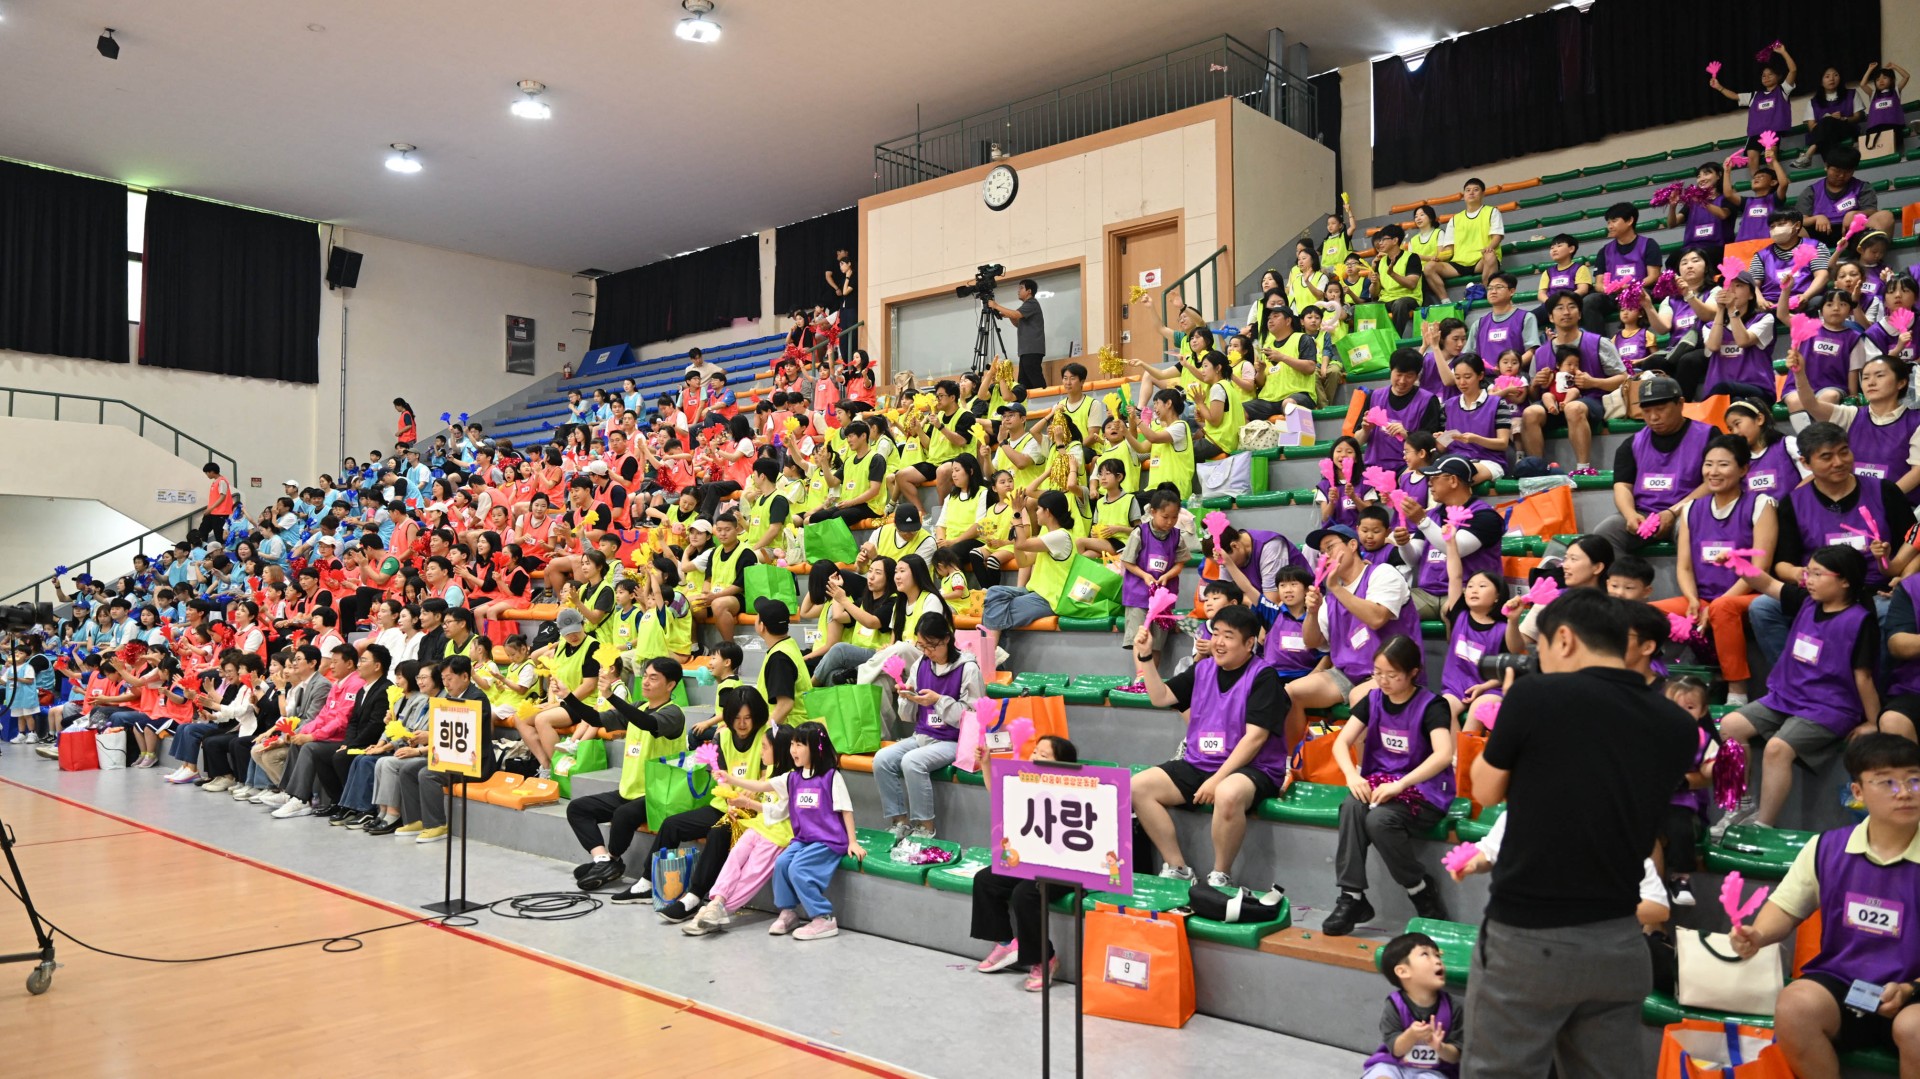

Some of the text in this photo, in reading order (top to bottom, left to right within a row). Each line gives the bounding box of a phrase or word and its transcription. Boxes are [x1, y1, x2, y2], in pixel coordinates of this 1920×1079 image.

[1841, 200, 1852, 208] 019
[1644, 381, 1652, 396] 1
[1752, 478, 1768, 486] 005
[440, 720, 469, 753] 희망
[1386, 738, 1403, 748] 022
[1020, 798, 1098, 852] 사랑
[1858, 909, 1890, 926] 022
[1124, 962, 1130, 973] 9
[1412, 1049, 1436, 1060] 022
